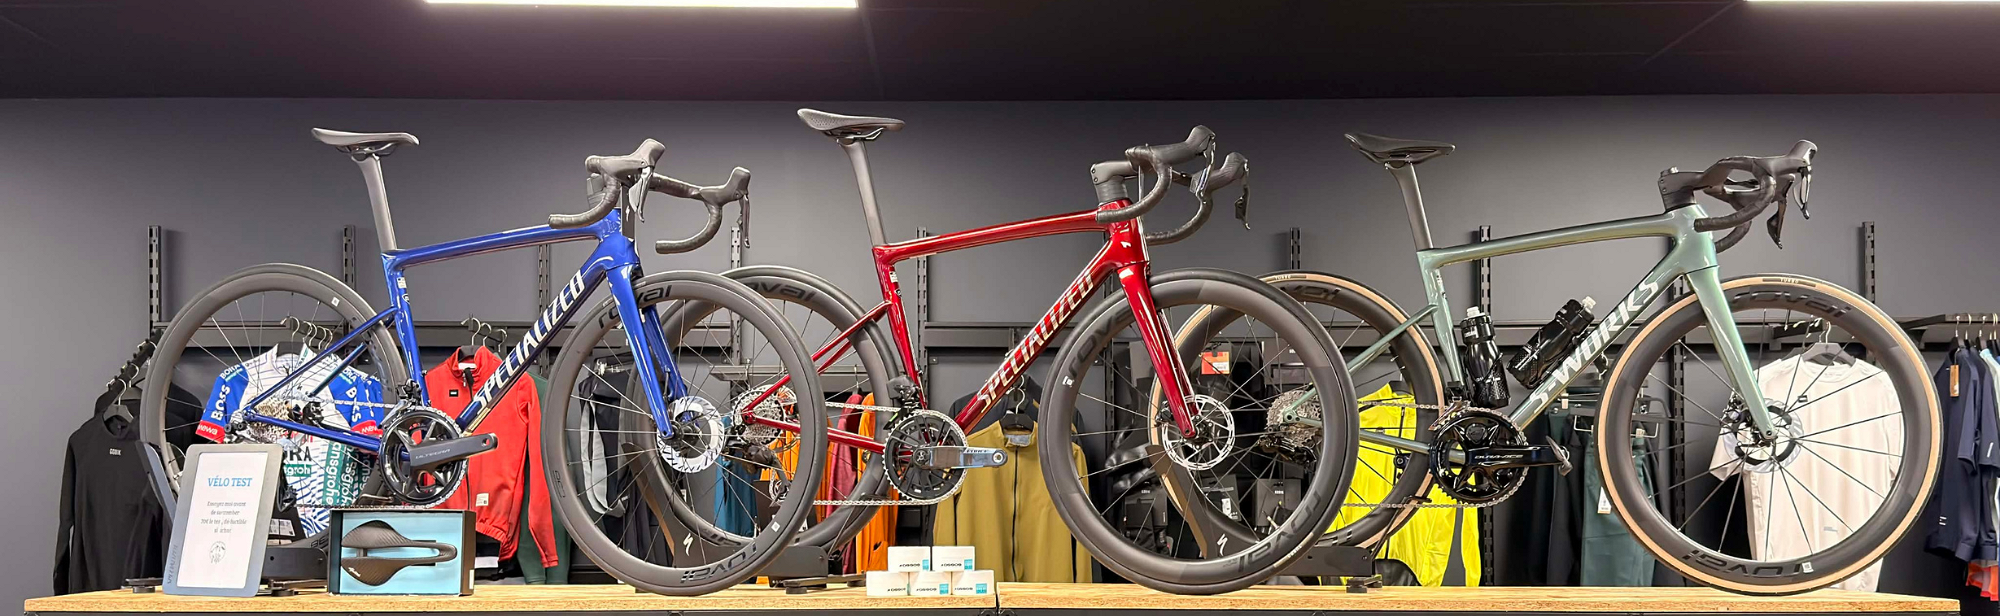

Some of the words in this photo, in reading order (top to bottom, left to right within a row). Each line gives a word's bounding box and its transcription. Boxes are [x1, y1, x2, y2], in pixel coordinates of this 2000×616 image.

[473, 270, 585, 414] SPECIALIZED
[977, 270, 1093, 413] SPECIALIZED
[1530, 272, 1659, 413] S-WORKS
[211, 384, 231, 420] BOSS
[208, 475, 230, 487] VÉLO
[232, 478, 252, 487] TEST
[325, 441, 342, 505] ansgrohe
